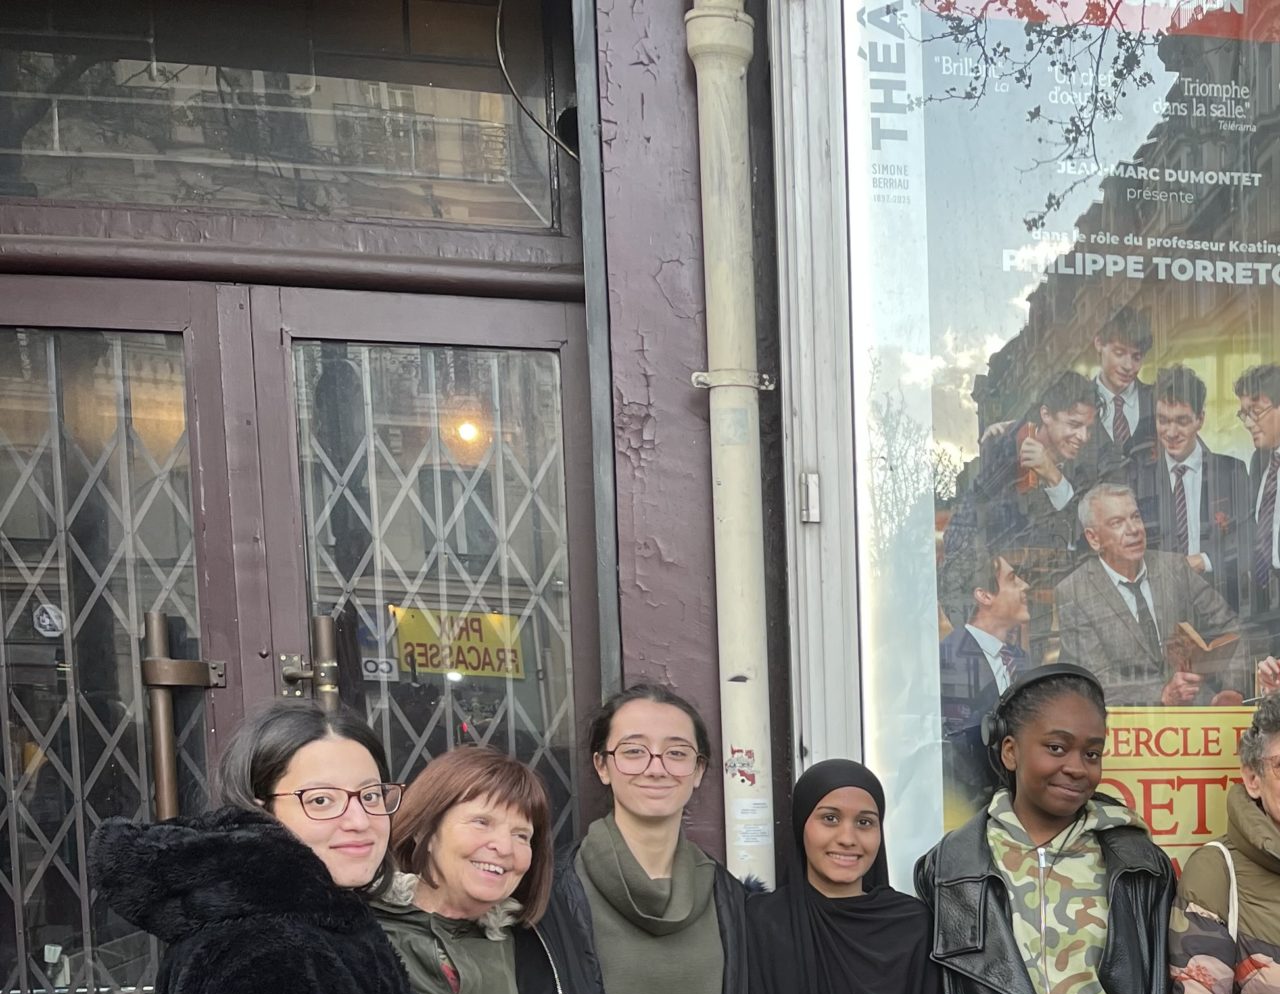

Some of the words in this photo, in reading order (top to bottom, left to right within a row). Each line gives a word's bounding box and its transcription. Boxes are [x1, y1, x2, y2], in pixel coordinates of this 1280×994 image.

[1176, 77, 1249, 102] "Triomphe
[1153, 98, 1188, 115] dans
[1193, 100, 1207, 116] la
[1218, 120, 1257, 132] Télérama
[872, 163, 909, 176] SIMONE
[1165, 169, 1262, 186] DUMONTET
[872, 177, 910, 190] BERRIAU
[1127, 186, 1194, 203] présente
[1032, 228, 1068, 241] dans
[1091, 231, 1119, 245] rôle
[1123, 233, 1143, 246] du
[1147, 235, 1226, 252] professeur
